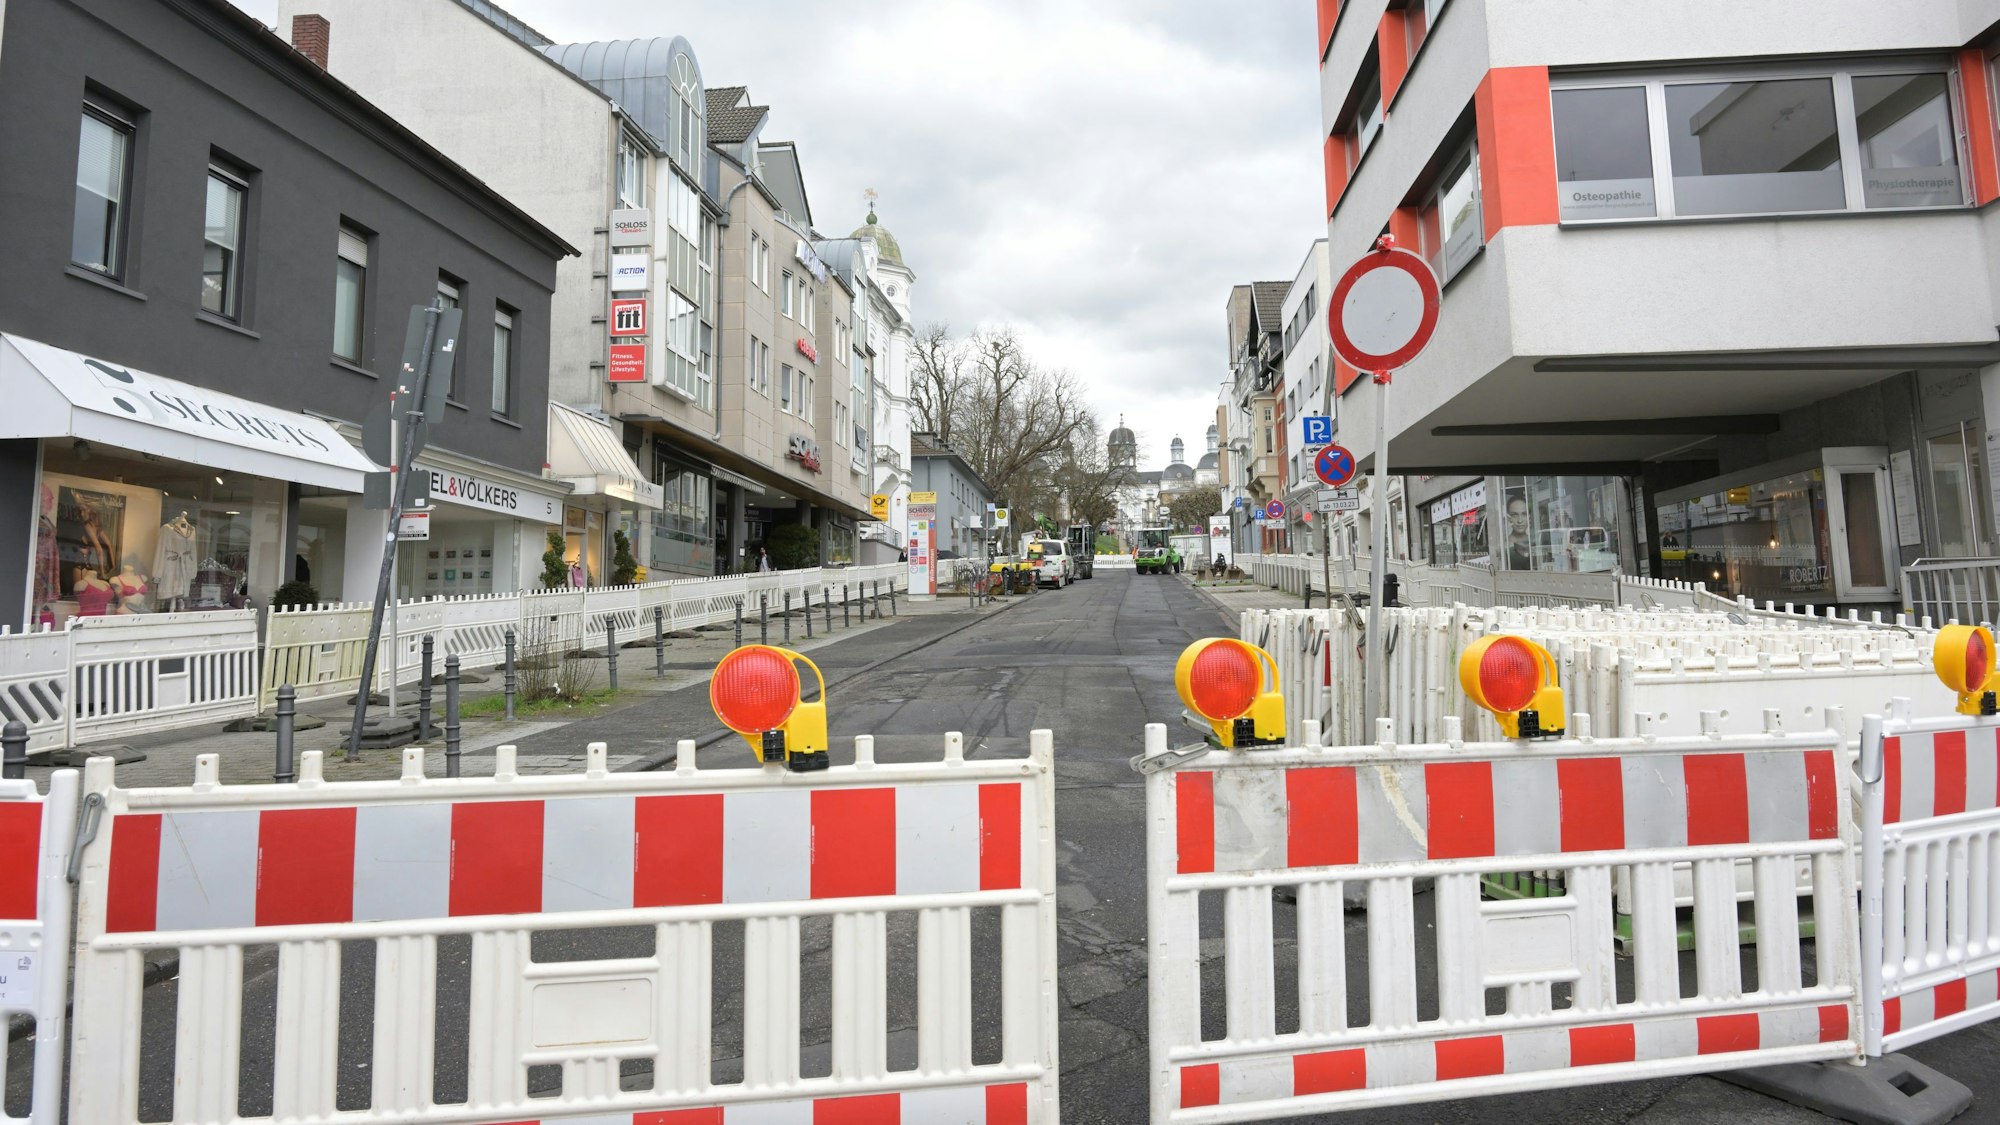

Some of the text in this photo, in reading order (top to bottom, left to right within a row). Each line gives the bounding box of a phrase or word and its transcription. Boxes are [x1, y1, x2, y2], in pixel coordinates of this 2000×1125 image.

[1868, 177, 1954, 191] Physiotherapie
[1572, 190, 1642, 202] Osteopathie
[615, 221, 648, 229] SCHLOSS
[618, 266, 646, 275] ACTION
[617, 310, 641, 329] fit
[149, 390, 330, 452] SECRETS
[1309, 419, 1325, 441] P
[546, 502, 552, 515] 5
[908, 506, 935, 514] SCHLOSS
[1332, 501, 1356, 509] 13.03.23
[1257, 510, 1263, 519] P
[1789, 565, 1829, 583] ROBERTZ
